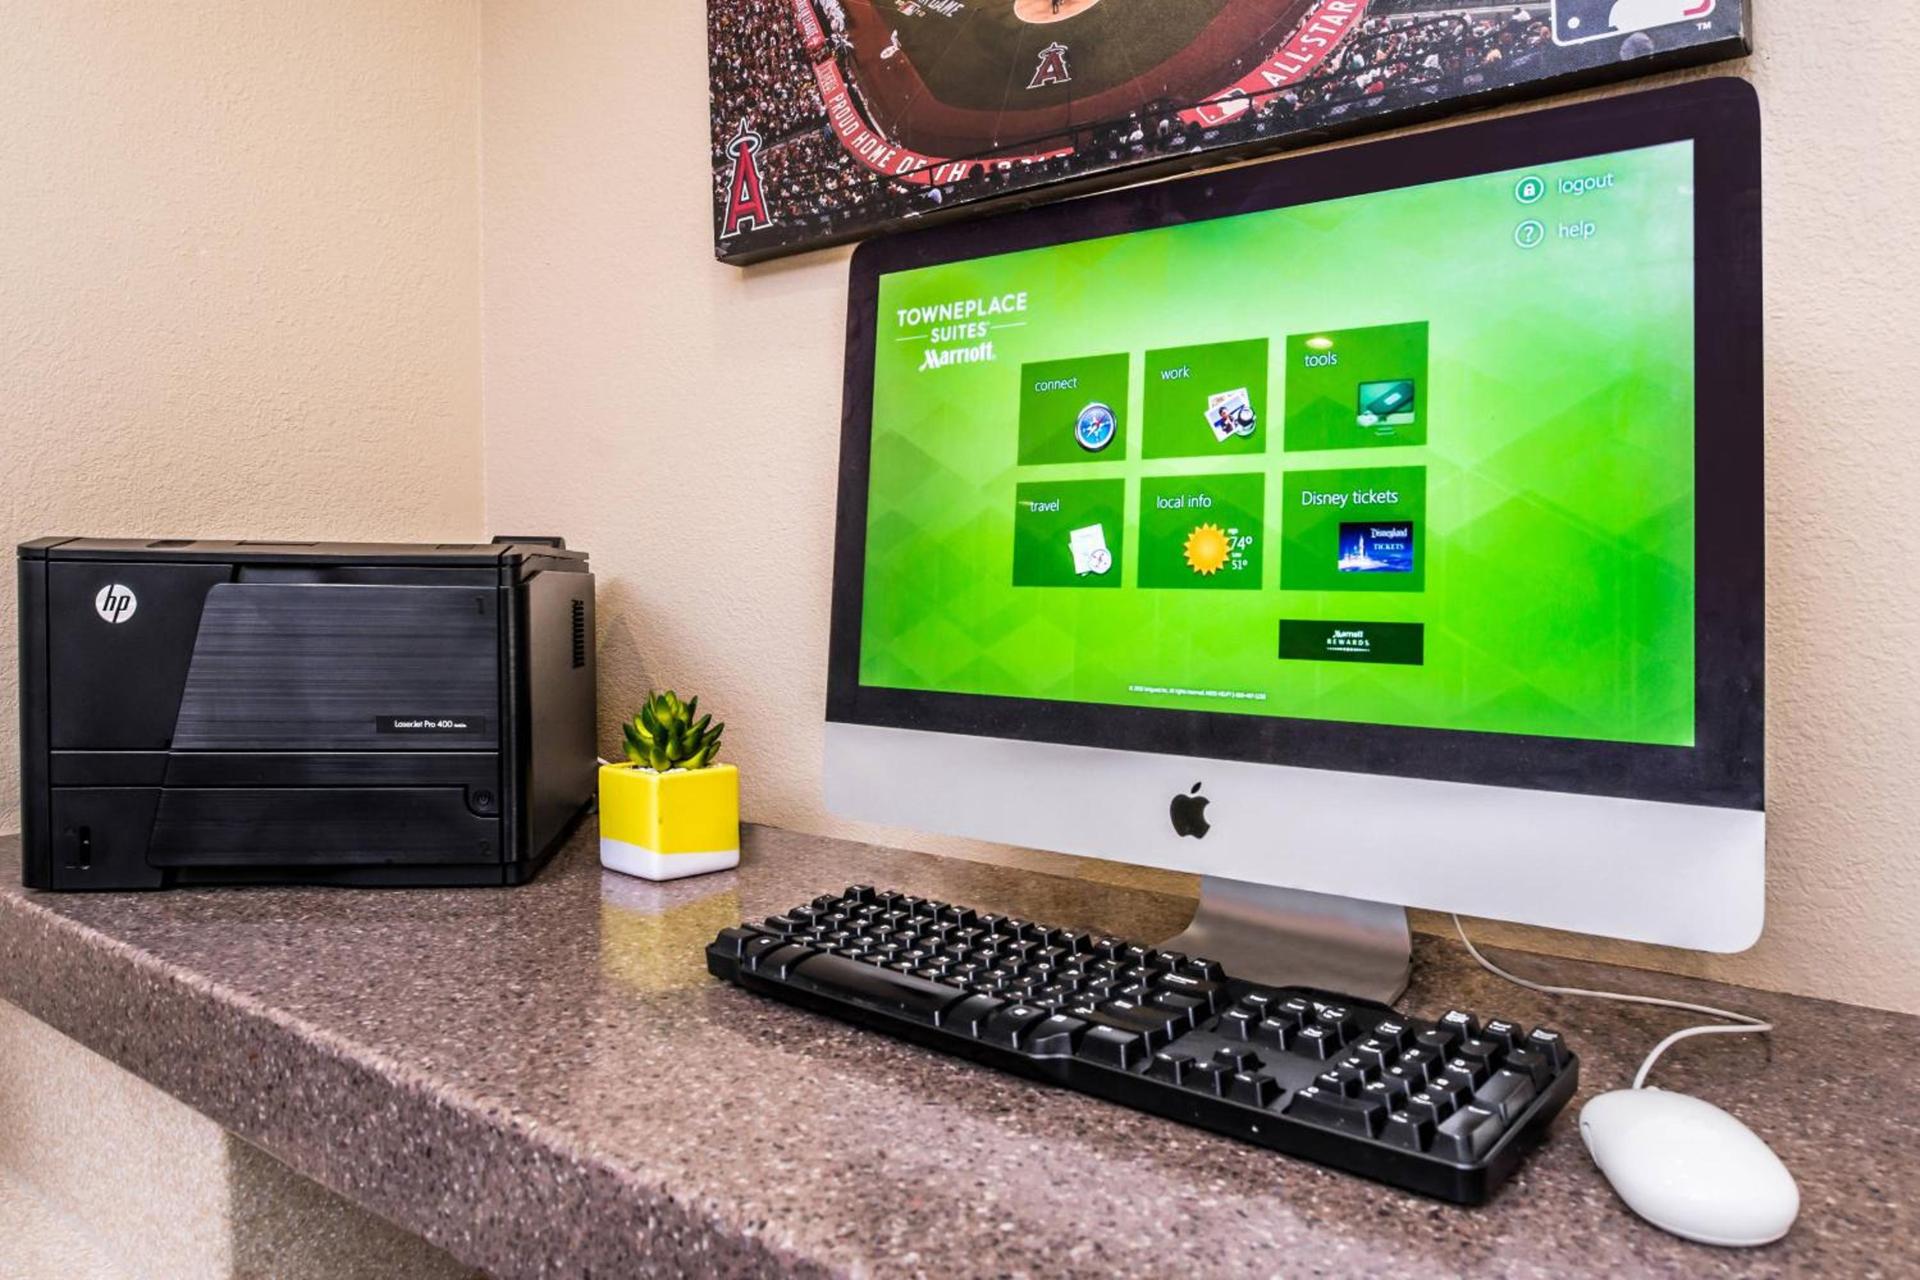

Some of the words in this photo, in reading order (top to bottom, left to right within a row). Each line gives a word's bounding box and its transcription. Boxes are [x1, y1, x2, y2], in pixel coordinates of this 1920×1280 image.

[1696, 21, 1712, 31] TM
[829, 92, 860, 137] PROUD
[851, 131, 897, 168] HOME
[895, 156, 928, 177] OF
[720, 118, 773, 239] A
[1558, 173, 1615, 195] logout
[1558, 219, 1596, 240] help
[897, 292, 1028, 328] TOWNEPLACE
[930, 321, 988, 343] SUITES
[918, 340, 993, 372] Marriott
[1304, 351, 1338, 367] tools
[1160, 365, 1191, 380] work
[1034, 376, 1079, 392] connect
[1030, 498, 1060, 512] travel
[1156, 494, 1185, 509] local
[1188, 493, 1212, 508] info
[1301, 490, 1349, 509] Disney
[1352, 488, 1399, 504] tickets
[101, 584, 131, 623] hp
[394, 720, 423, 729] LaserJet
[424, 720, 436, 729] Pro
[437, 720, 453, 729] 400
